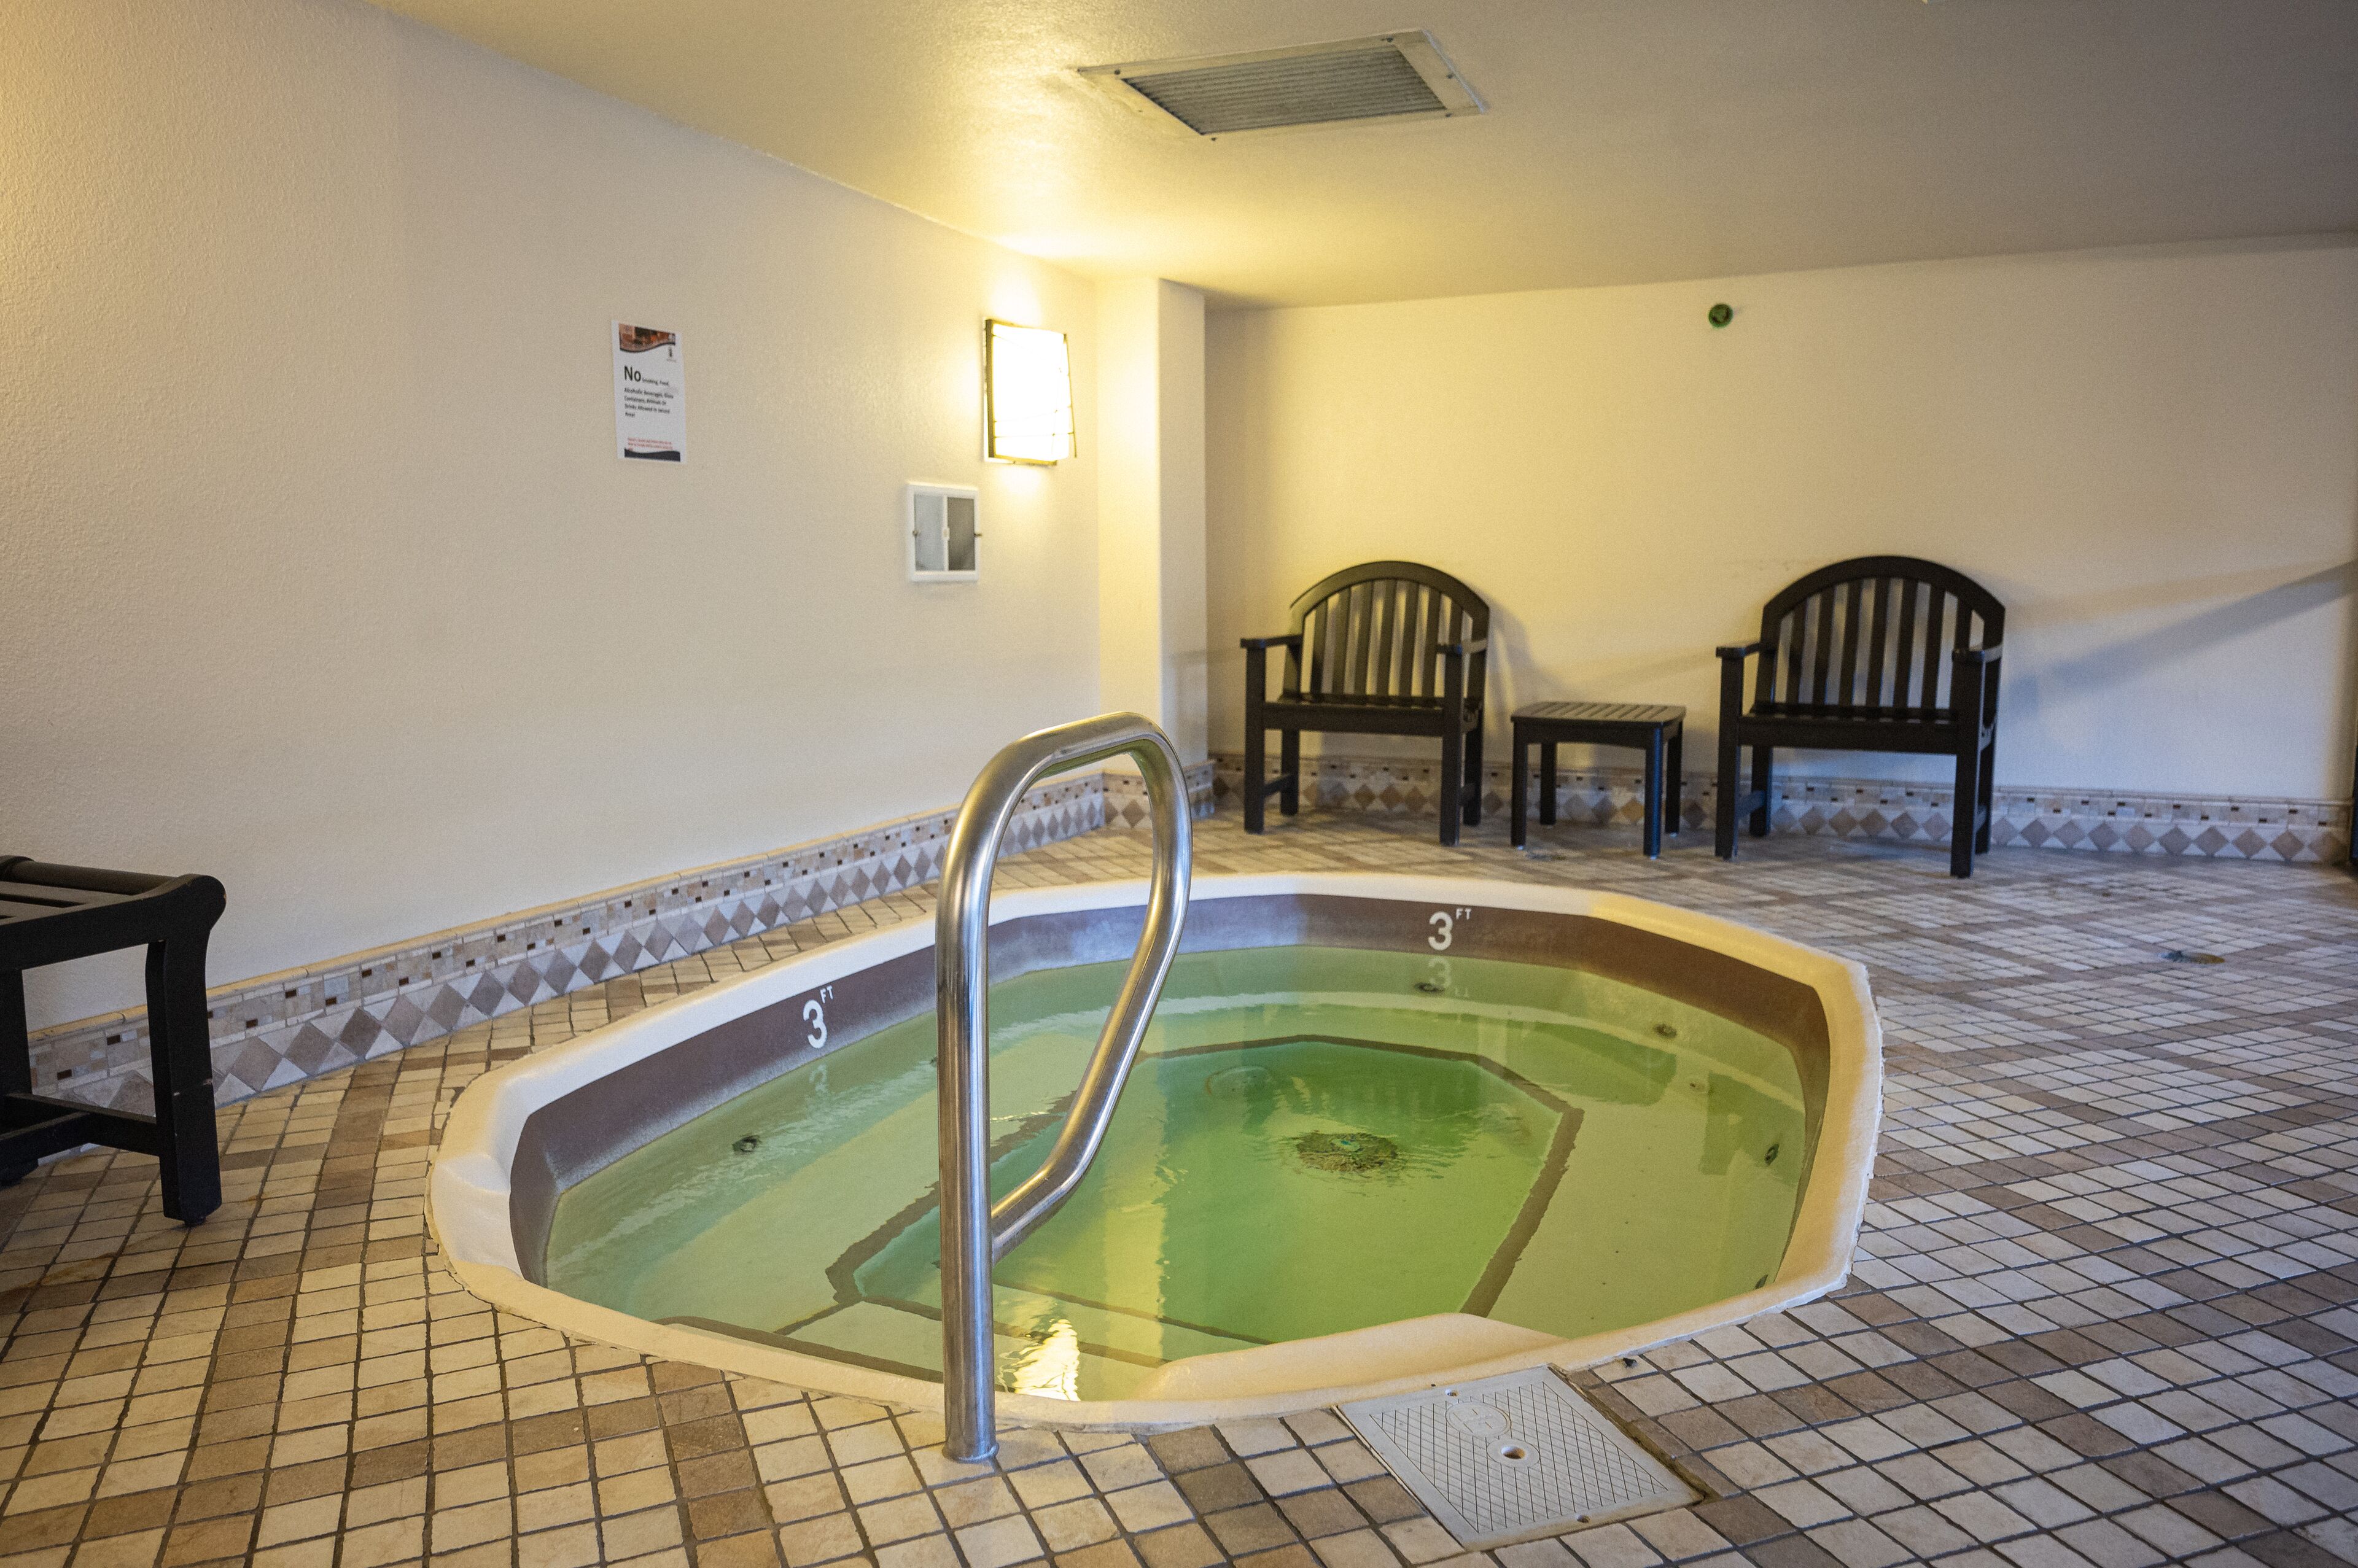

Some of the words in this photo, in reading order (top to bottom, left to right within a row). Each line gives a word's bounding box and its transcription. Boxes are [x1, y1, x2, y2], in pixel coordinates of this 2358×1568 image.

[624, 365, 641, 382] No
[1428, 910, 1453, 951] 3
[1455, 907, 1472, 920] FT
[803, 999, 828, 1049] 3
[820, 985, 833, 1004] FT
